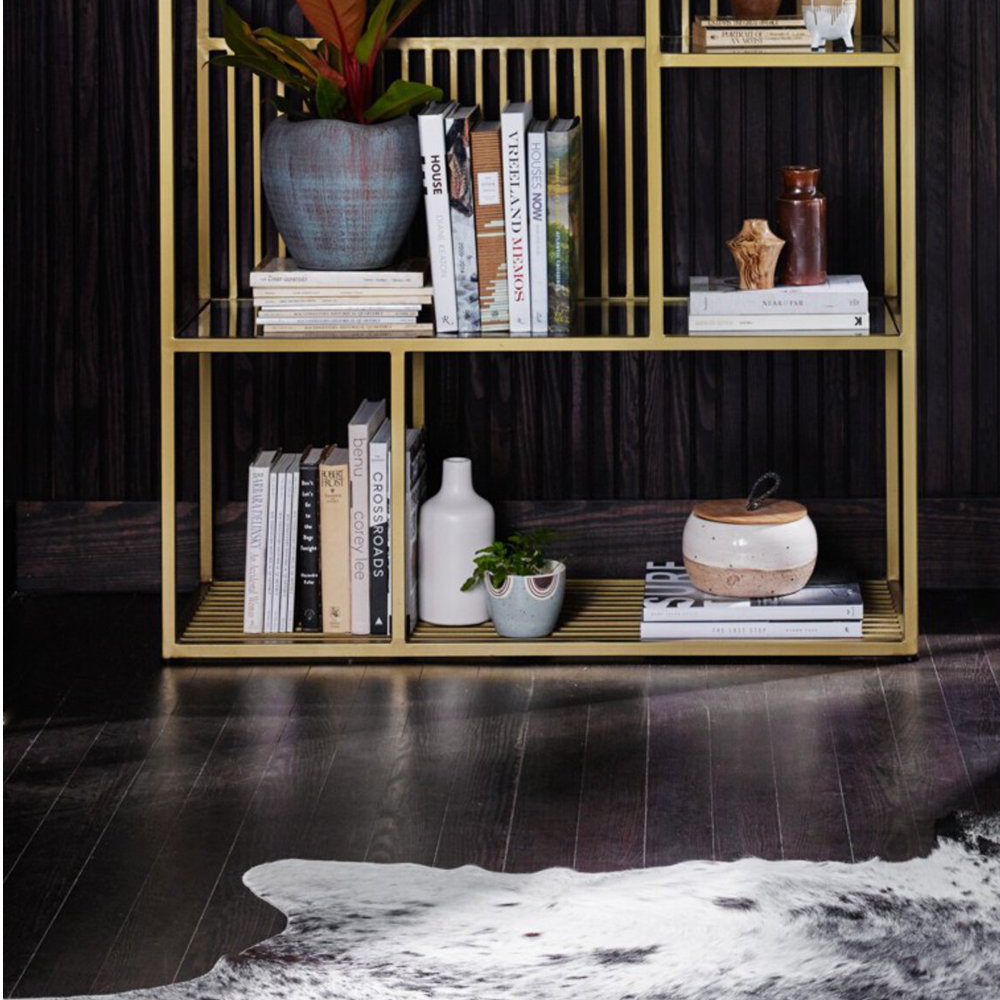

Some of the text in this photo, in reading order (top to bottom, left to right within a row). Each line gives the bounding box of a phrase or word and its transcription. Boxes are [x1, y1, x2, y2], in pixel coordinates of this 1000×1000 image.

[430, 154, 443, 195] HOUSE
[531, 142, 542, 190] HOUSES
[508, 131, 525, 303] VREELAND MEMOS
[532, 193, 543, 222] NOW
[352, 437, 364, 477] benu
[251, 472, 264, 510] BARBARA
[351, 510, 368, 581] corey lee
[372, 471, 385, 578] CROSSROADS
